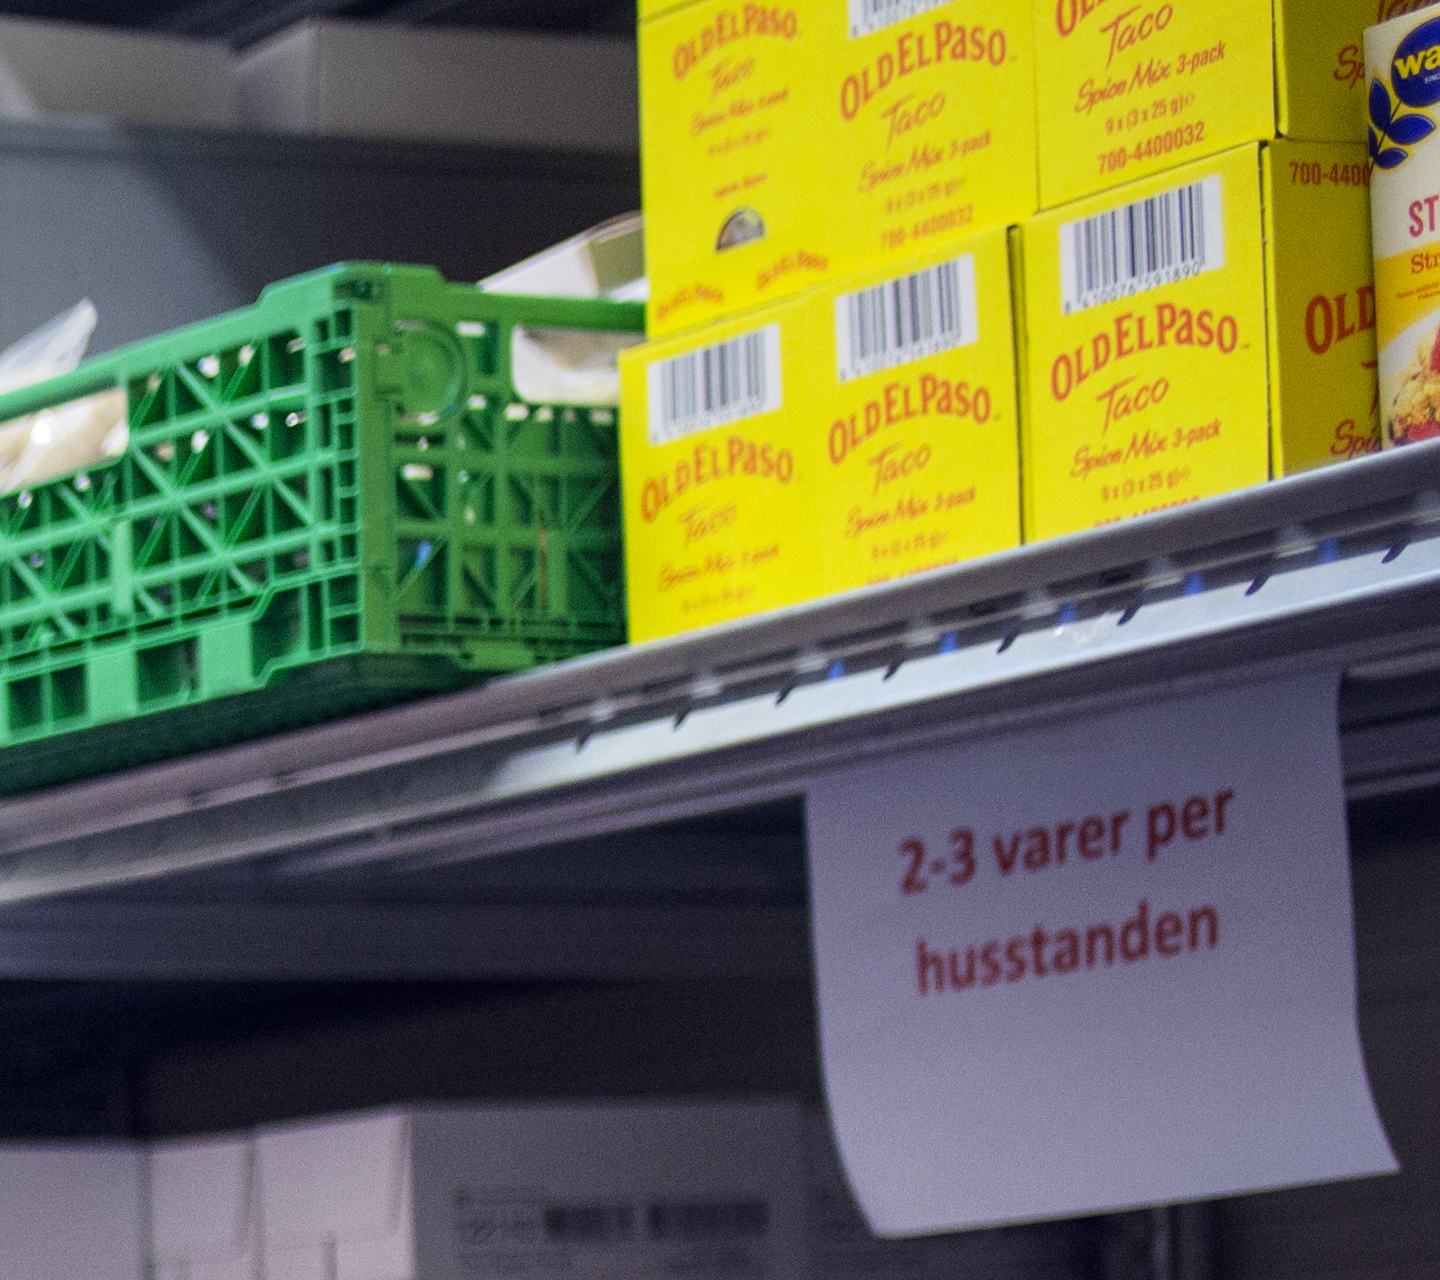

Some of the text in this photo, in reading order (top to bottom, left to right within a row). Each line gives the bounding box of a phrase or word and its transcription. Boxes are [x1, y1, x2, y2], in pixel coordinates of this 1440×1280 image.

[1100, 3, 1174, 71] Taco
[840, 52, 895, 121] OLD
[897, 31, 931, 77] EL
[1074, 40, 1226, 116] Spice Mix 3-pack
[881, 92, 946, 150] Taco
[1097, 120, 1205, 175] 700-4400032
[1050, 331, 1112, 403] OLD
[1113, 311, 1153, 363] EL
[828, 398, 880, 467] OLD
[883, 379, 918, 428] EL
[1096, 373, 1170, 437] Taco
[867, 441, 932, 497] Taco
[898, 788, 1236, 897] 2-3 varer per
[916, 900, 1221, 997] husstanden
